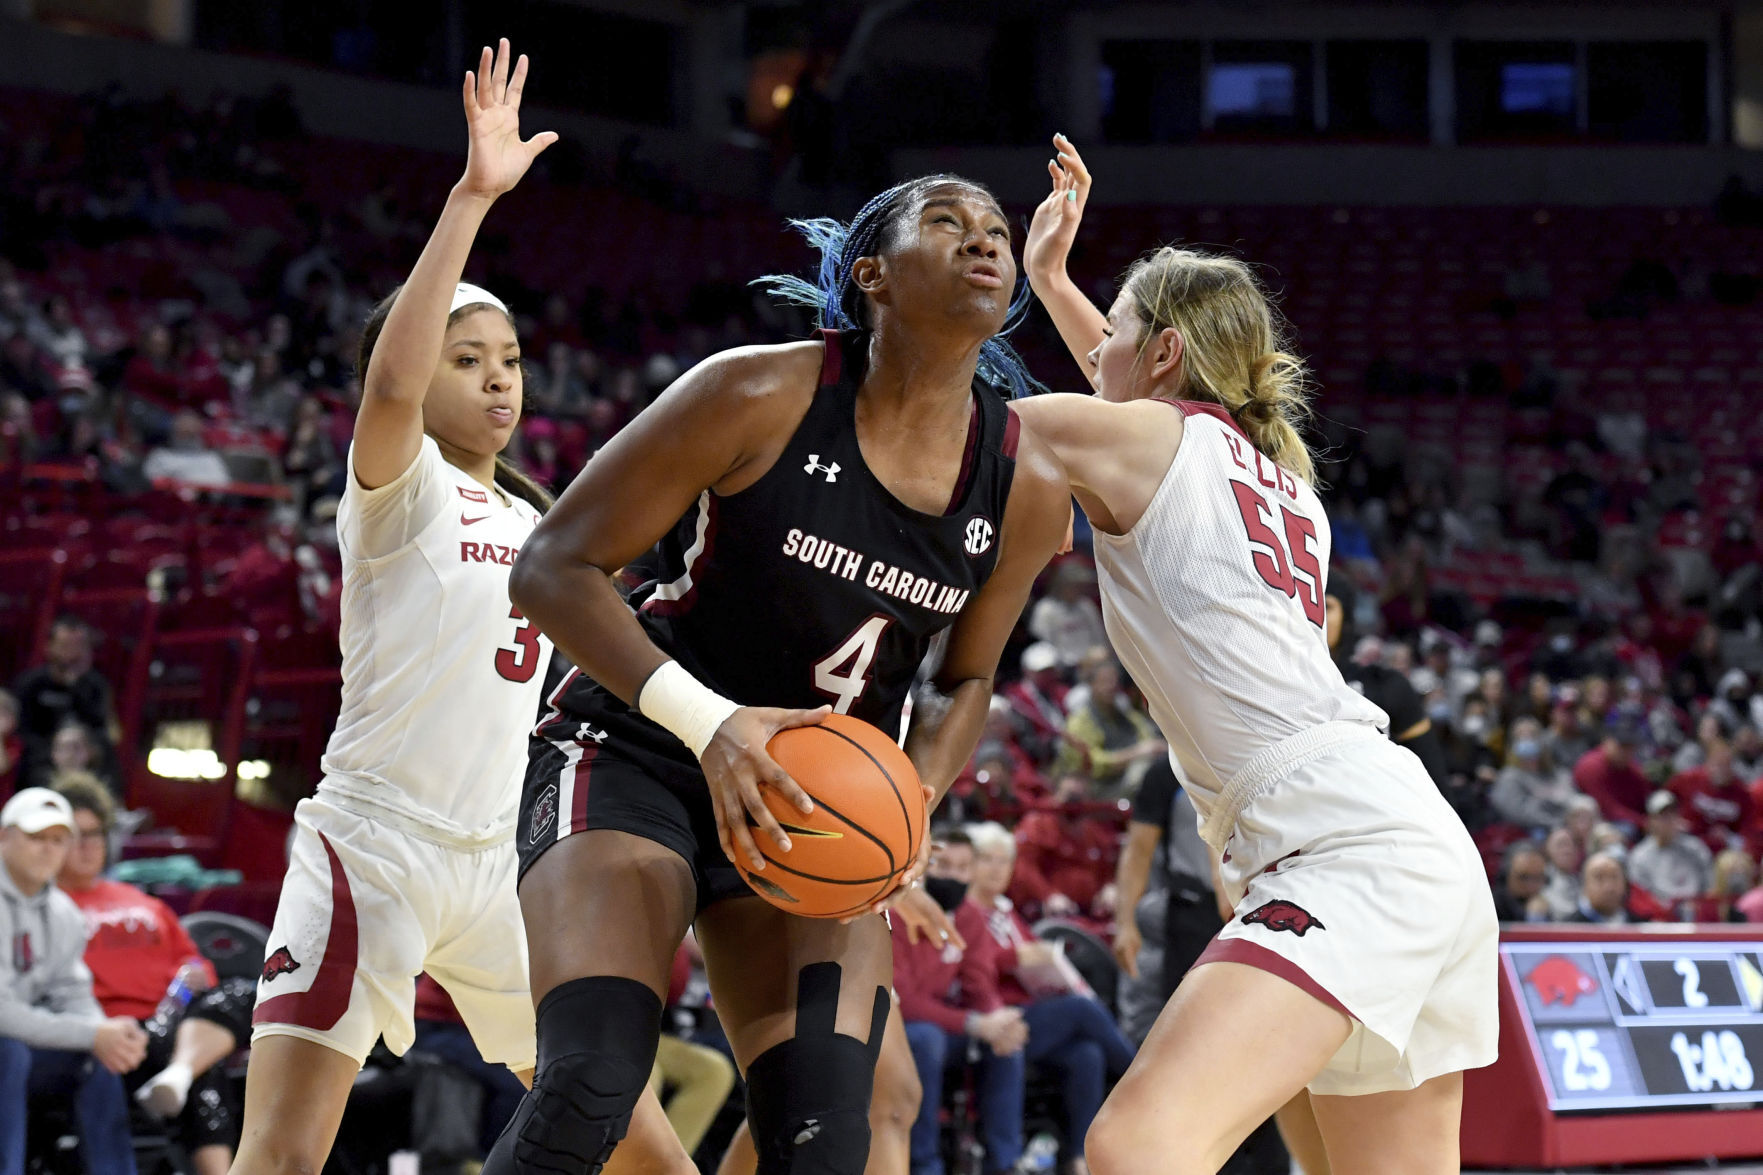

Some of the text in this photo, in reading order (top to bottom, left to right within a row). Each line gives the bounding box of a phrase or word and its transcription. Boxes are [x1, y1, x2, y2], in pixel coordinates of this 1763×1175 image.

[782, 528, 970, 614] SOUTH CAROLINA
[964, 517, 994, 555] SEC
[1229, 479, 1326, 630] 55
[494, 604, 541, 684] 3
[812, 613, 893, 715] 4
[1673, 956, 1710, 1009] 2
[1551, 1028, 1612, 1091] 25
[1670, 1030, 1755, 1092] 1:48
